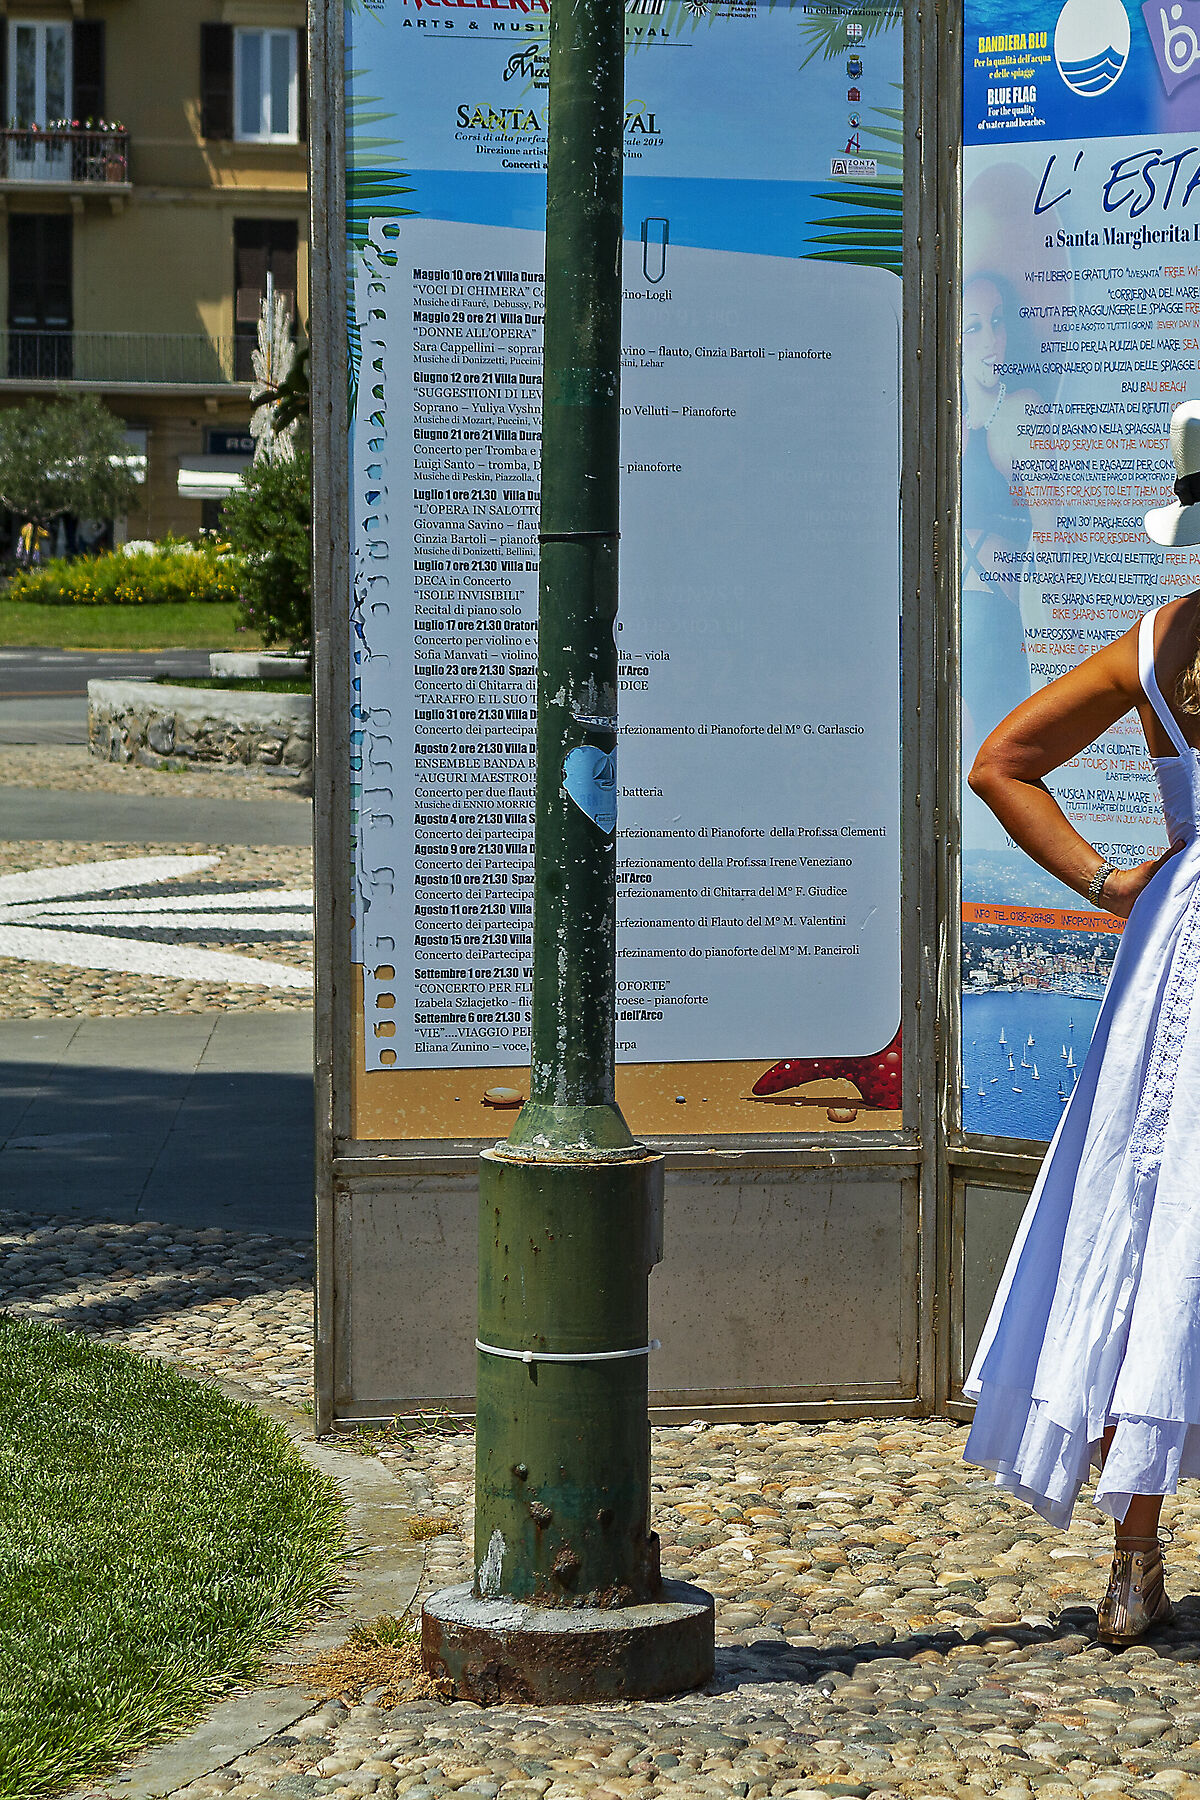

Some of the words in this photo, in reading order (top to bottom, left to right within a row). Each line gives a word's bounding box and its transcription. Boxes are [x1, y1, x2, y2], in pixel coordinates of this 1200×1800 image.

[803, 5, 814, 14] In
[816, 6, 882, 17] collaborazione
[403, 19, 454, 29] ARTS
[469, 21, 479, 30] &
[979, 34, 1027, 53] BANDIERA
[1028, 32, 1047, 49] BLU
[974, 58, 985, 67] Per
[986, 57, 992, 66] la
[994, 55, 1016, 68] qualità
[994, 69, 1009, 78] delle
[1011, 68, 1035, 79] spiagge
[988, 87, 1011, 105] BLUE
[1013, 86, 1036, 103] FLAG
[988, 107, 999, 116] For
[1000, 106, 1011, 115] the
[1012, 104, 1035, 117] quality
[456, 104, 542, 131] SANTA
[978, 120, 985, 129] of
[986, 120, 1004, 129] water
[1006, 118, 1018, 127] and
[1019, 117, 1045, 127] beaches
[455, 132, 481, 141] Corsi
[483, 133, 493, 142] di
[495, 134, 514, 143] alto
[643, 138, 664, 146] 2019
[476, 145, 521, 155] Direzione
[502, 159, 541, 169] Concerti
[1045, 234, 1053, 247] a
[1056, 229, 1099, 247] Santa
[1103, 224, 1189, 250] Margherita
[413, 268, 450, 280] Maggio
[452, 270, 462, 280] 10
[466, 271, 482, 280] ore
[484, 271, 494, 281] 21
[496, 271, 518, 281] Villa
[1025, 272, 1045, 282] WI-FI
[1046, 271, 1072, 282] LIBERO
[1075, 271, 1080, 280] E
[1082, 269, 1123, 280] GRATUITO
[1164, 266, 1185, 278] FREE
[452, 286, 464, 295] DI
[413, 342, 437, 352] Sara
[440, 342, 494, 354] Cappellini
[1041, 341, 1079, 353] BATTELLO
[1081, 341, 1098, 353] PER
[1098, 342, 1108, 351] LA
[1110, 340, 1138, 351] PULIZIA
[1140, 340, 1155, 350] DEL
[1157, 339, 1180, 351] MARE
[1183, 339, 1199, 350] SEA
[659, 346, 692, 358] flauto,
[695, 347, 727, 358] Cinzia
[730, 348, 765, 359] Bartoli
[778, 349, 832, 360] pianoforte
[640, 359, 664, 367] Lehar
[1121, 382, 1138, 393] BAU
[1140, 382, 1157, 393] BAU
[1160, 381, 1186, 392] BEACH
[635, 405, 668, 416] Velluti
[682, 406, 736, 418] Pianoforte
[1025, 403, 1064, 416] RACCOLTA
[1065, 403, 1124, 416] DIFFERENZIATA
[1127, 403, 1140, 414] DEI
[1142, 402, 1169, 414] RIFIUTI
[414, 444, 462, 455] Concerto
[465, 446, 482, 456] per
[485, 445, 527, 455] Tromba
[414, 575, 447, 586] DECA
[450, 576, 460, 585] in
[463, 576, 511, 586] Concerto
[415, 604, 451, 615] Recital
[454, 605, 464, 615] di
[468, 605, 497, 617] piano
[500, 605, 521, 615] solo
[415, 620, 444, 631] Luglio
[446, 620, 455, 630] 17
[458, 622, 474, 630] ore
[476, 620, 500, 630] 21.30
[414, 650, 441, 660] Sofia
[444, 650, 488, 660] Manvati
[645, 650, 670, 661] viola
[698, 724, 708, 735] di
[711, 725, 764, 735] Pianoforte
[767, 725, 782, 735] del
[803, 725, 814, 734] G.
[817, 725, 864, 735] Carlascio
[1107, 744, 1141, 756] GUIDATE
[415, 758, 480, 768] ENSEMBLE
[484, 759, 525, 768] BANDA
[623, 786, 663, 797] batteria
[1112, 843, 1145, 856] STORICO
[698, 857, 723, 868] della
[727, 857, 766, 868] Prof.ssa
[769, 857, 796, 867] Irene
[799, 857, 852, 867] Veneziano
[975, 909, 990, 918] INFO
[414, 968, 466, 979] Settembre
[468, 968, 472, 978] 1
[475, 970, 491, 978] ore
[494, 968, 518, 978] 21.30
[415, 998, 452, 1008] Izabela
[456, 997, 508, 1009] Szlacjetko
[621, 1010, 663, 1021] dell’Arco
[415, 1042, 448, 1052] Eliana
[451, 1042, 489, 1052] Zunino
[502, 1043, 529, 1052] voce,
